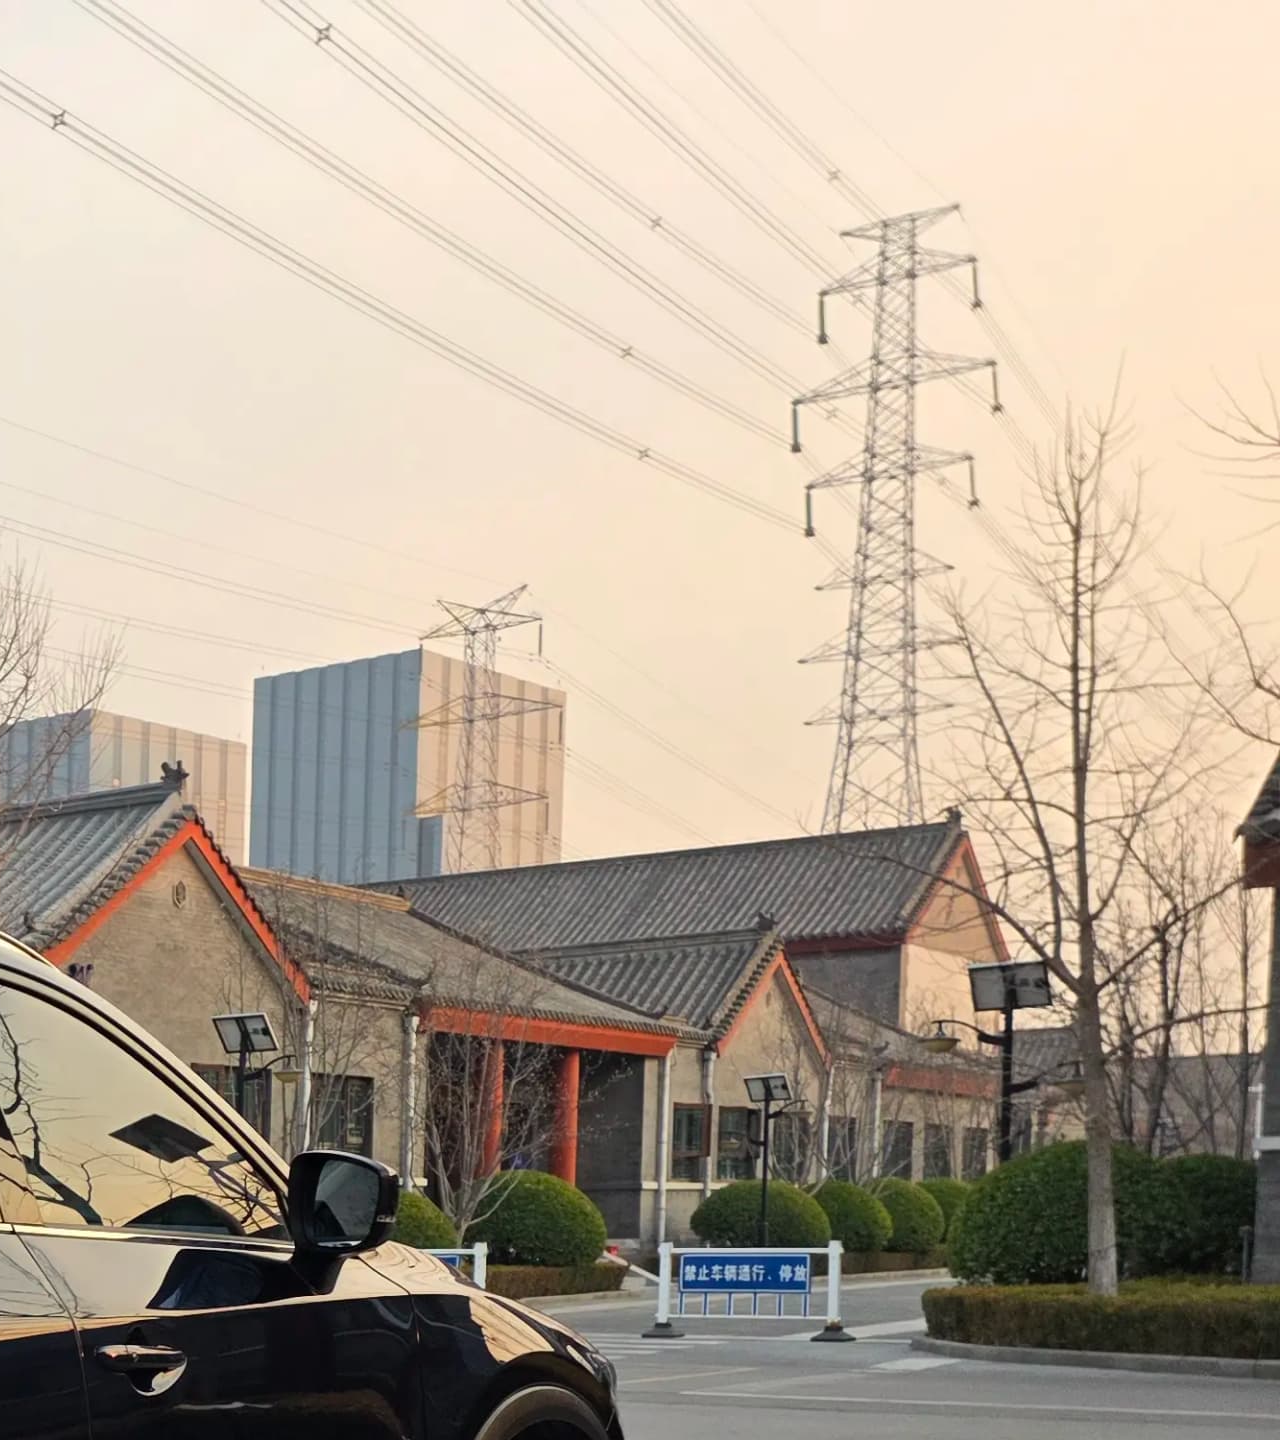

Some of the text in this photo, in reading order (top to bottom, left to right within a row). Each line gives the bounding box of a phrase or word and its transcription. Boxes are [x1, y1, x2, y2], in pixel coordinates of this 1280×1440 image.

[684, 1264, 807, 1282] 禁止车辆通行、停放
